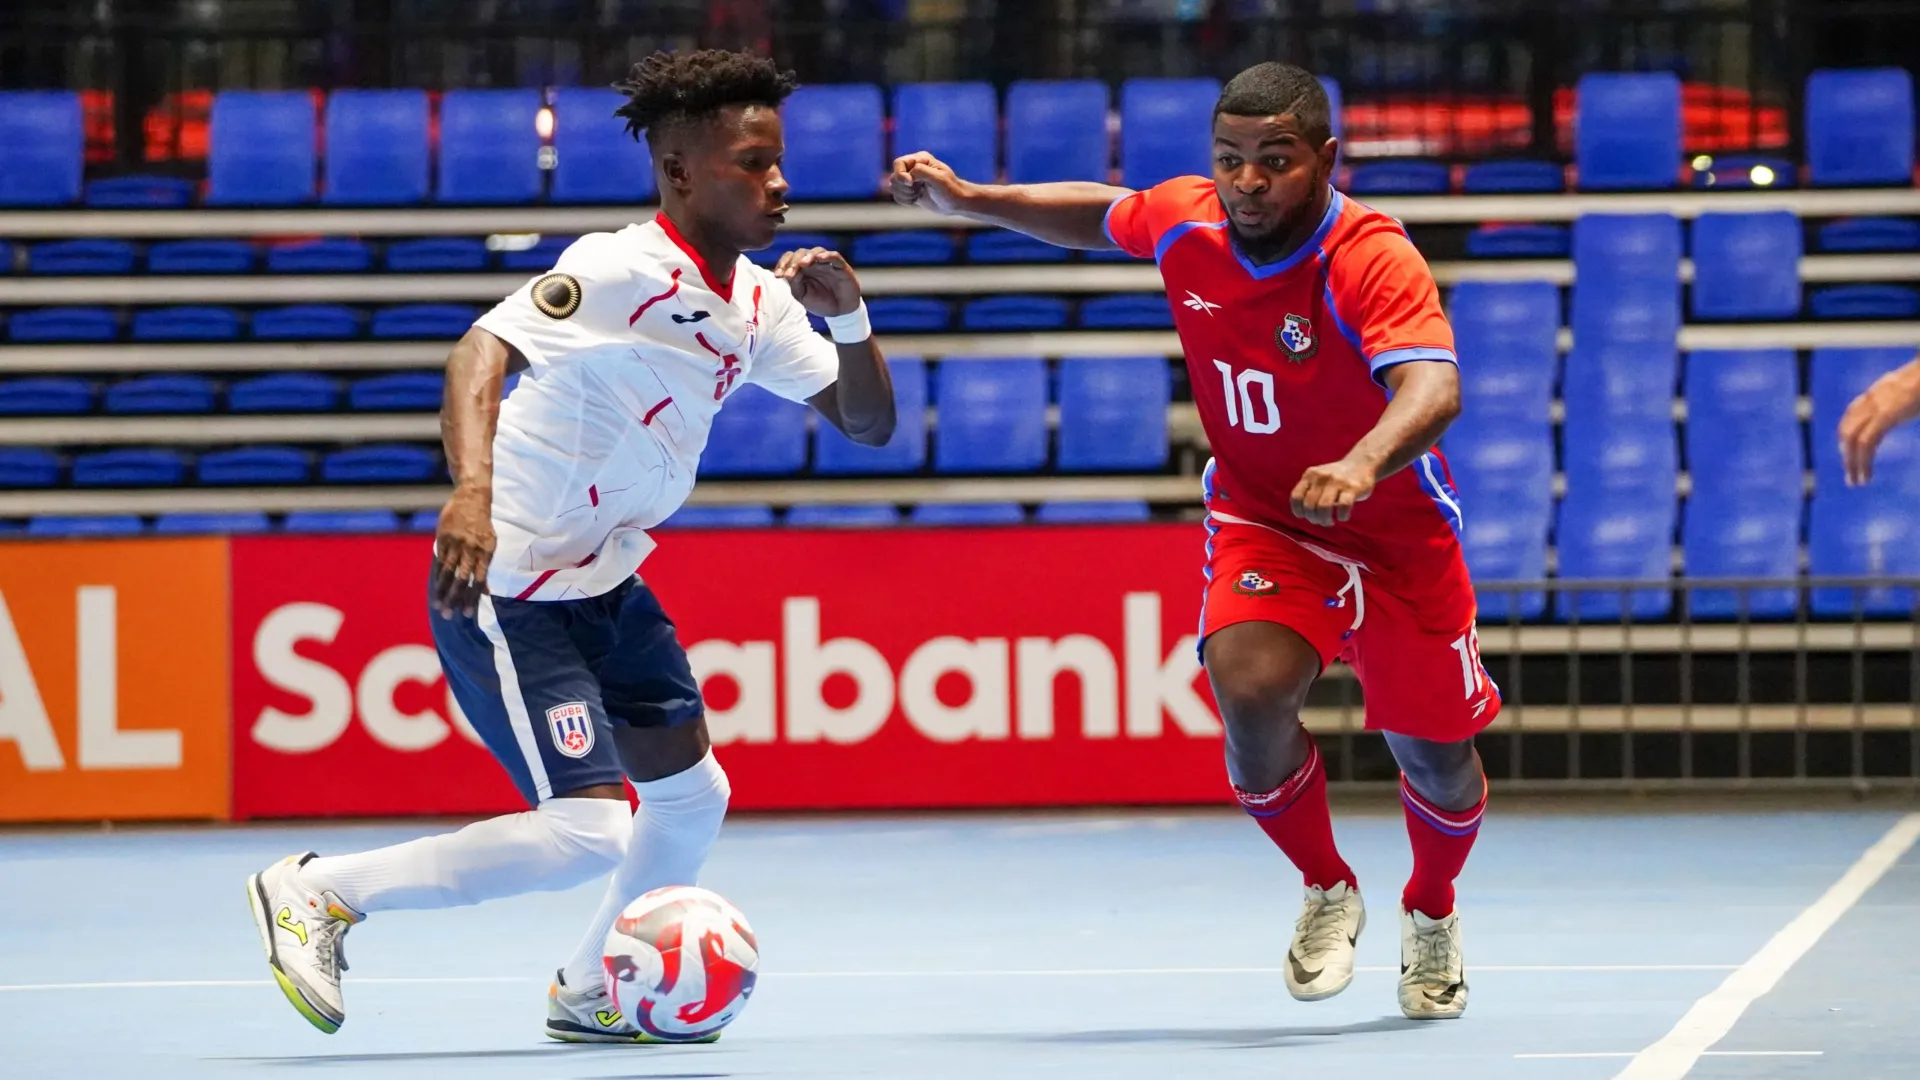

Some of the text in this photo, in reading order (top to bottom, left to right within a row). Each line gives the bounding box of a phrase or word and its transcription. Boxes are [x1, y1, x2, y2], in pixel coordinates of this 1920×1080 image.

[1213, 359, 1281, 434] 10
[250, 591, 1223, 753] Scabank
[553, 707, 582, 720] CUBA
